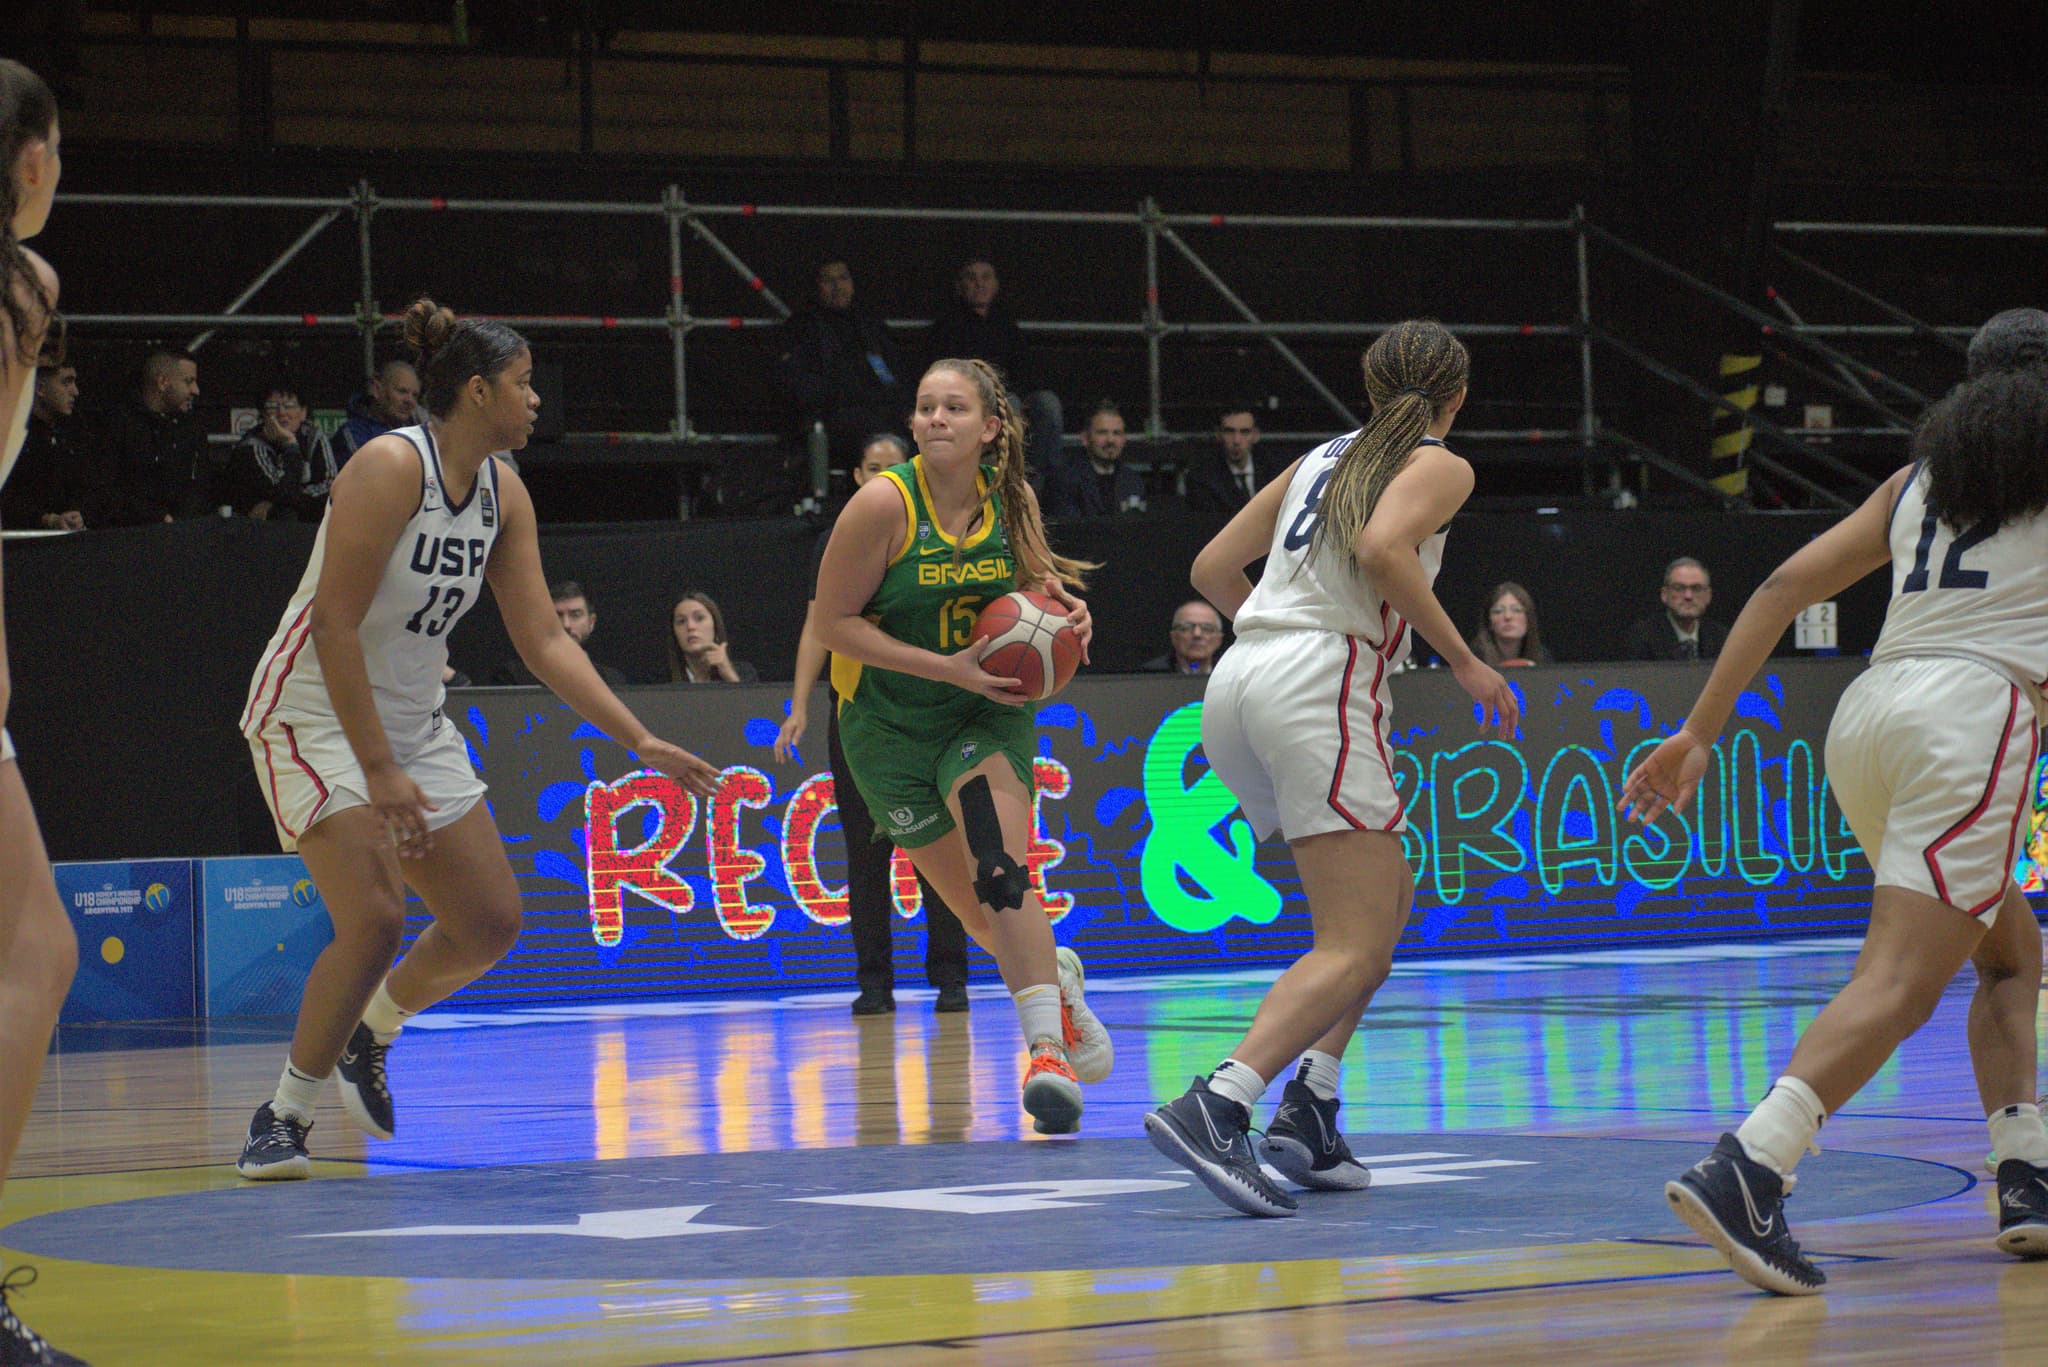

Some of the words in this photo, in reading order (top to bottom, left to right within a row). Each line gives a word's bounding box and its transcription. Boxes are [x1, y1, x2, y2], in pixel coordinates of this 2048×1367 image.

[410, 533, 485, 577] USA
[1902, 497, 2000, 594] 12
[918, 558, 1012, 585] BRASIL
[405, 586, 465, 637] 13
[939, 595, 983, 648] 15
[584, 757, 1075, 947] RECE
[1141, 702, 1283, 933] &
[75, 892, 95, 907] U18
[224, 887, 244, 903] U18
